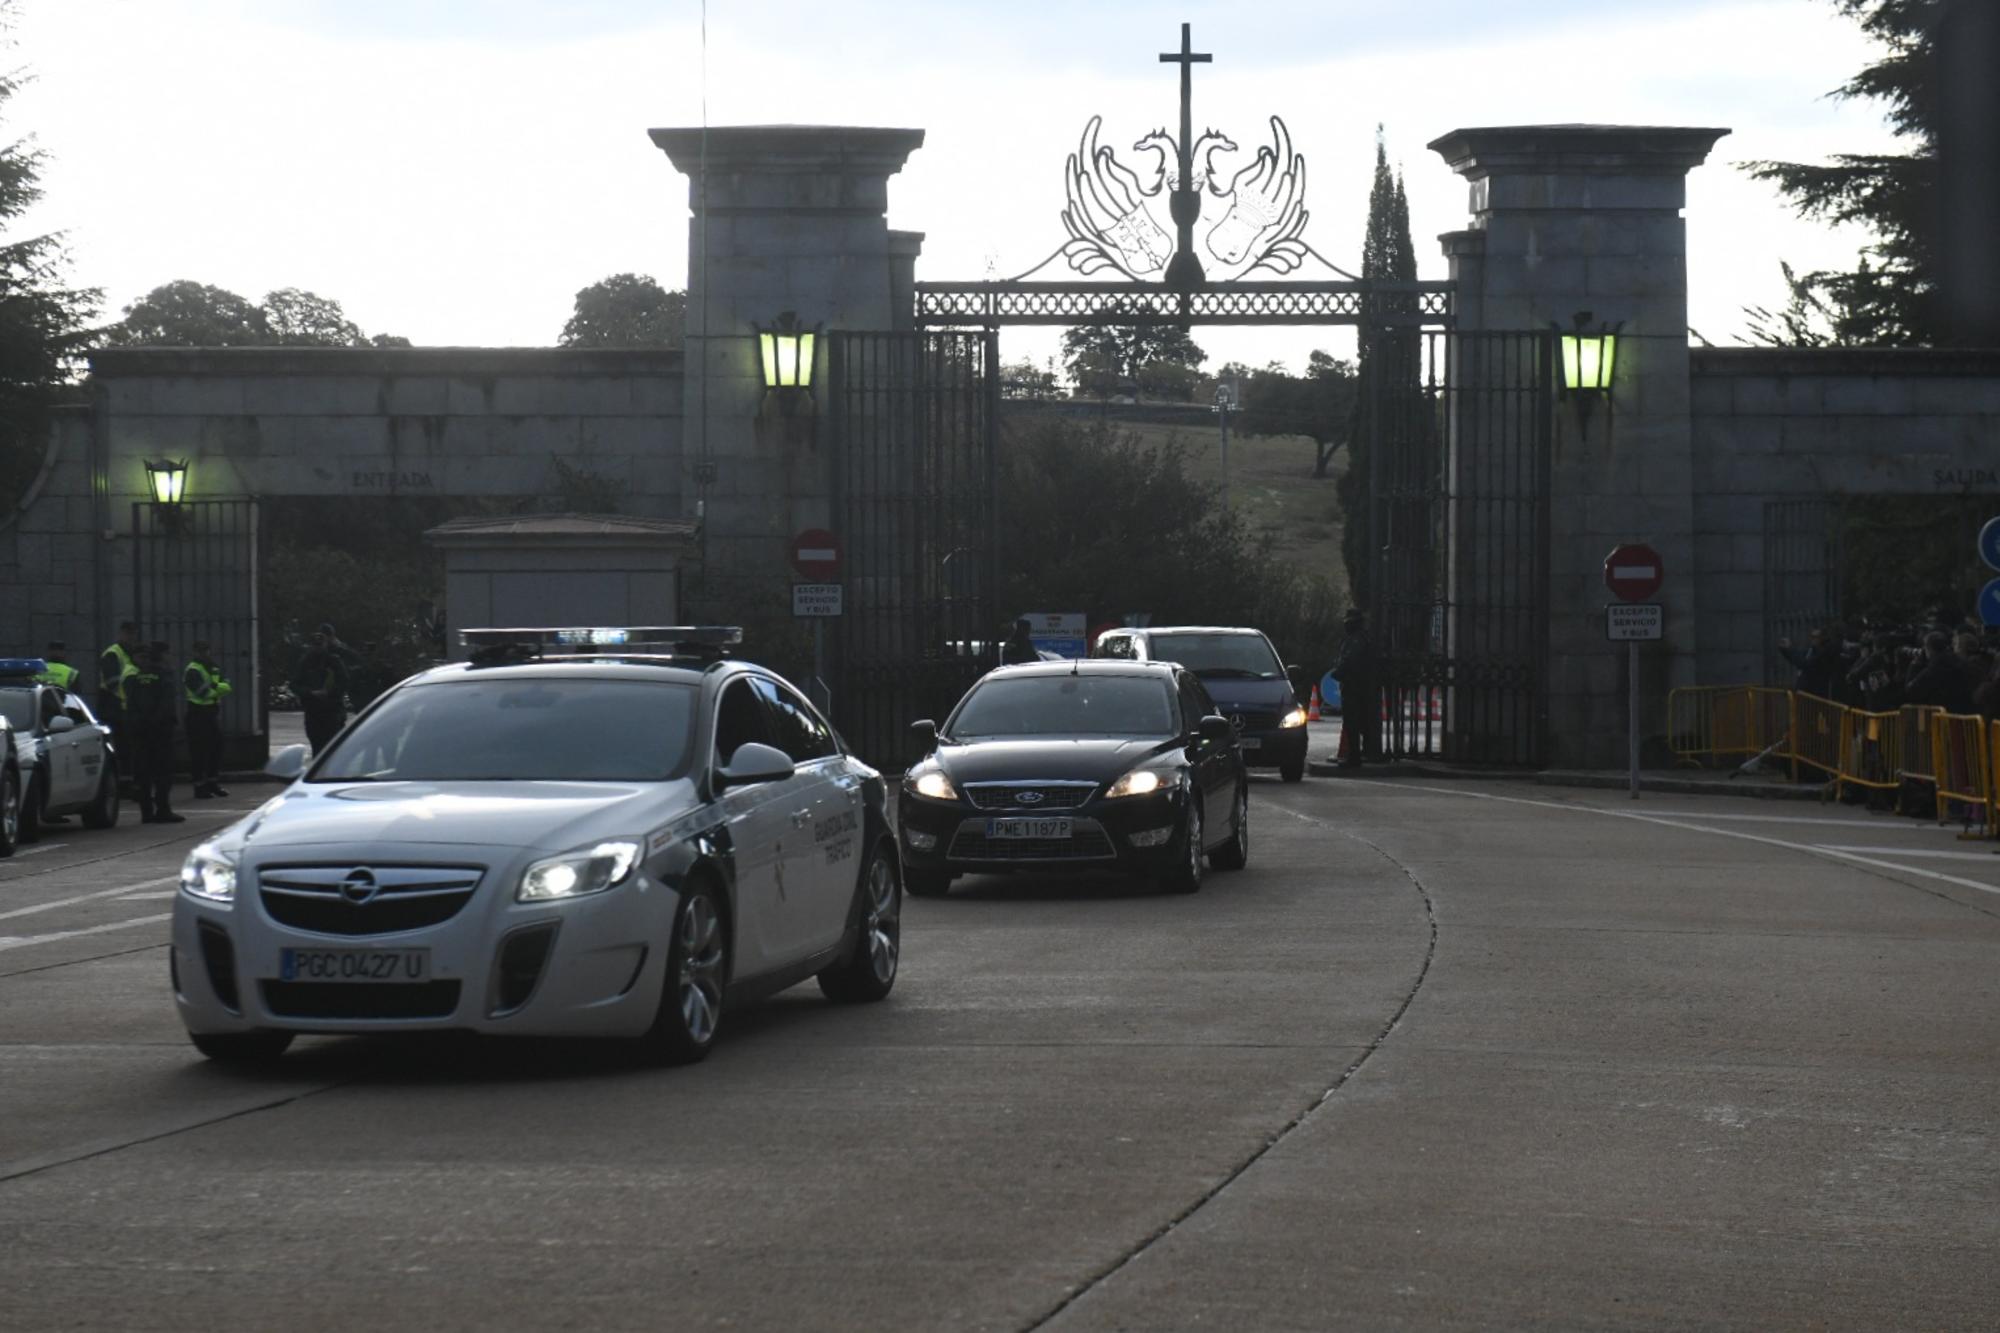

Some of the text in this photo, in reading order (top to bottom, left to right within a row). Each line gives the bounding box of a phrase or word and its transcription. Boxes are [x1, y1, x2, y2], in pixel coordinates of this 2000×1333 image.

[352, 471, 434, 488] ENTRADA
[1933, 467, 1998, 486] SALIDA
[1613, 617, 1658, 626] SERVICIO
[1629, 628, 1650, 637] BUS
